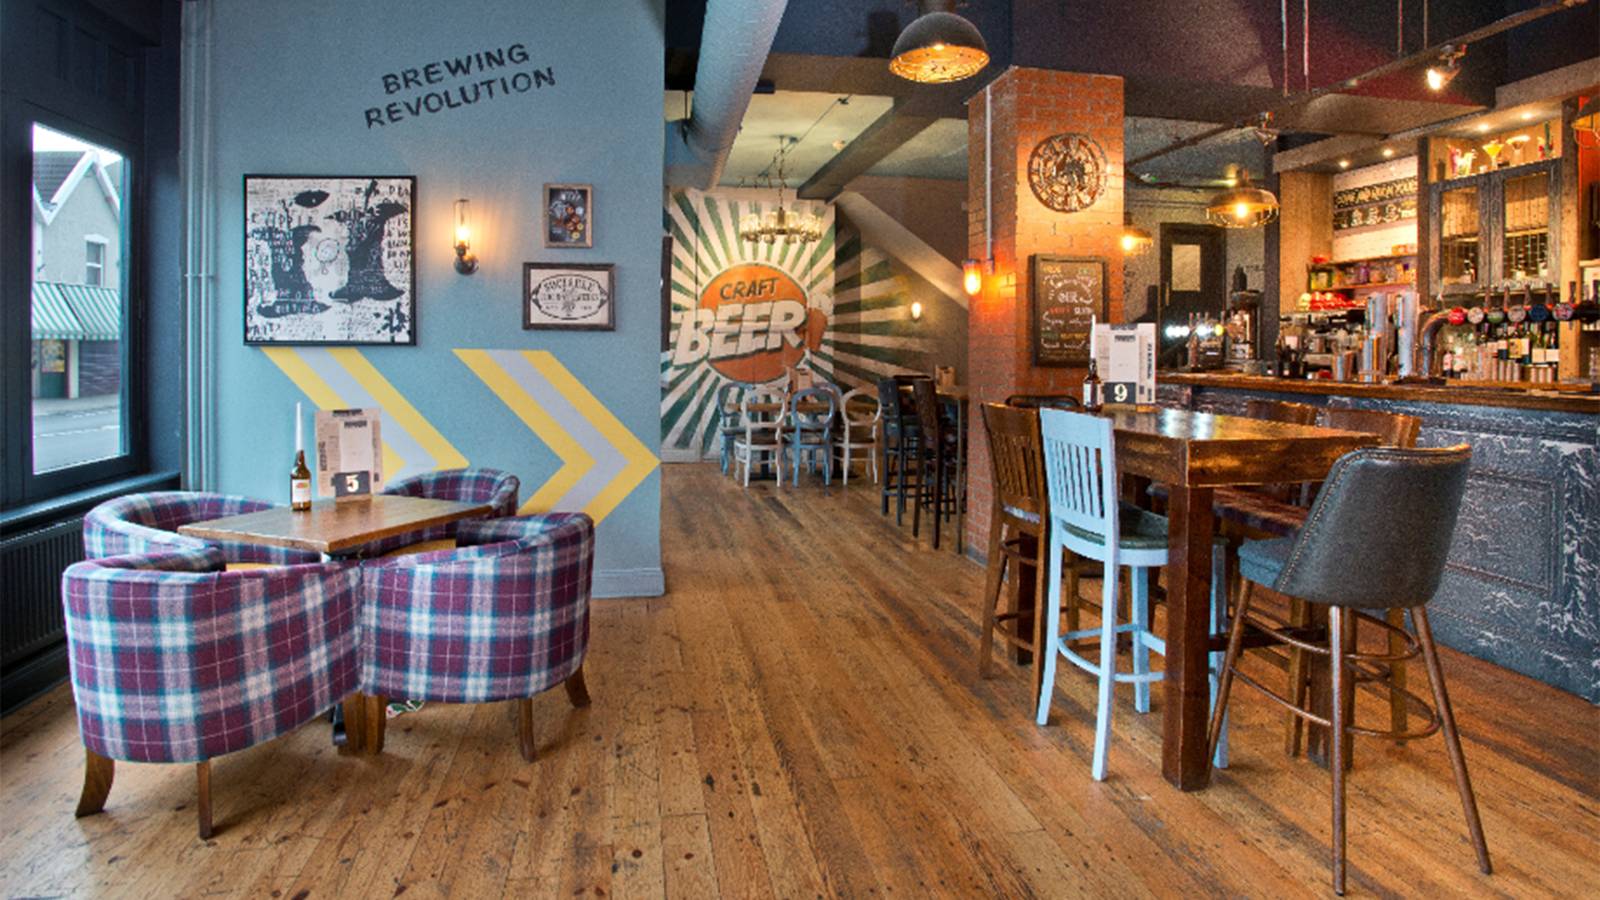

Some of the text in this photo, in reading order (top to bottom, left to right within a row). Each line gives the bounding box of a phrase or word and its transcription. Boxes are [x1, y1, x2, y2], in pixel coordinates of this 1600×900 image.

[382, 43, 530, 95] BREWING
[364, 67, 556, 129] REVOLUTION
[719, 277, 780, 300] CRAFT
[672, 300, 806, 366] BEER
[1114, 383, 1128, 402] 9
[345, 474, 360, 493] 5
